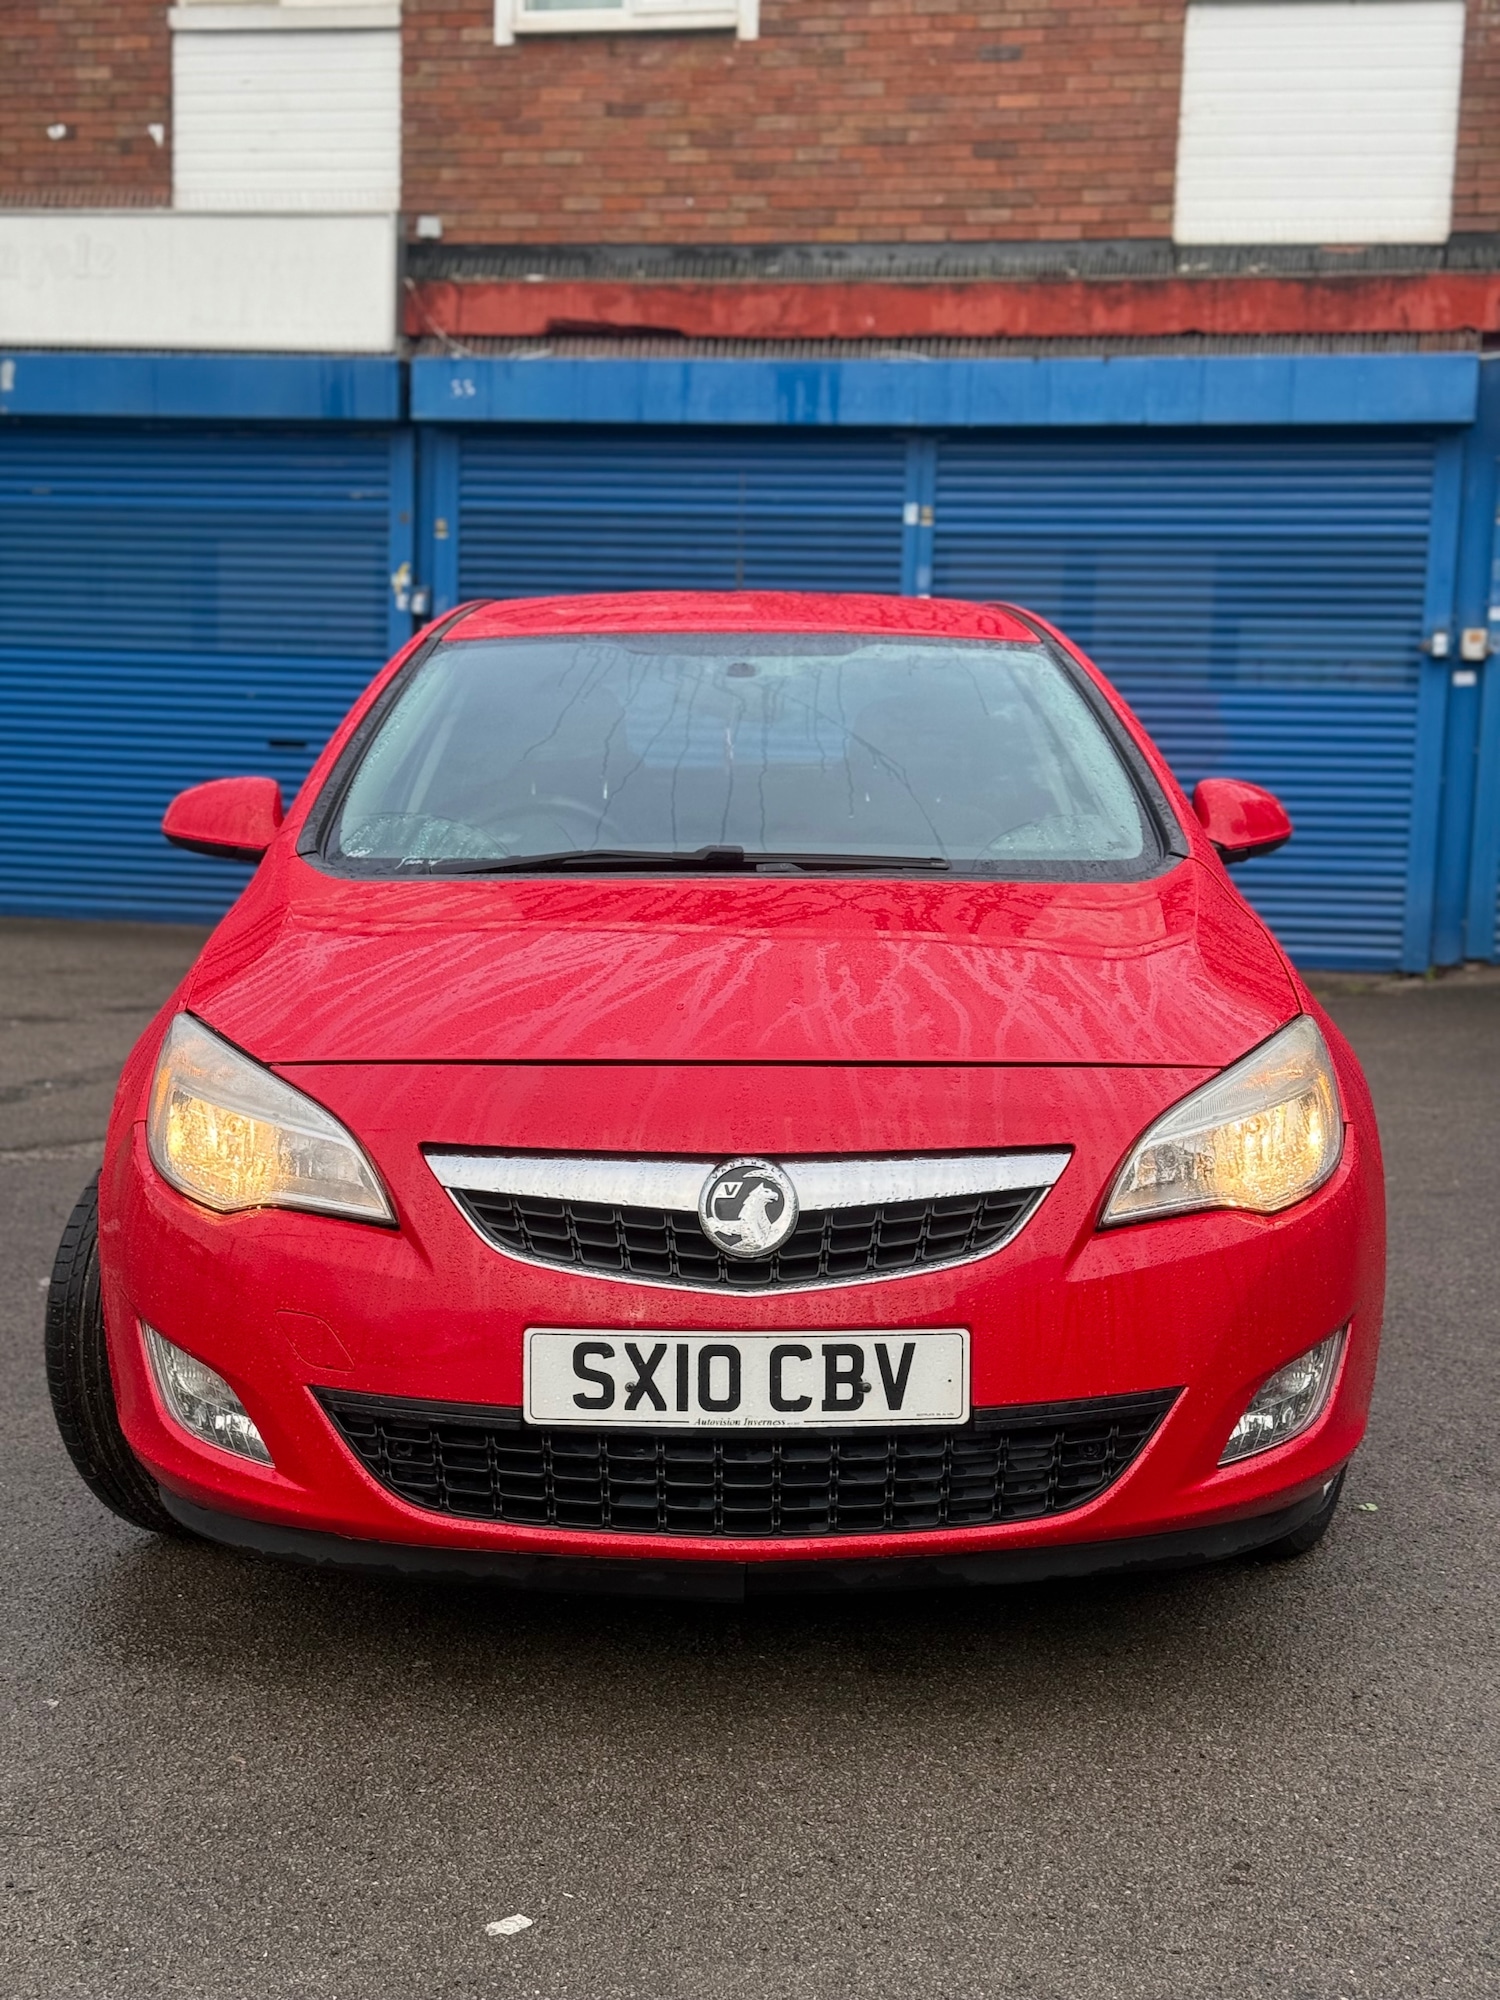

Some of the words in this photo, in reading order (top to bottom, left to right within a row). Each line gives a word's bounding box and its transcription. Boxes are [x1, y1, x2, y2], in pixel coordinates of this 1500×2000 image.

[724, 1184, 738, 1196] V
[573, 1342, 741, 1412] SX10
[770, 1343, 916, 1412] CBV
[694, 1417, 740, 1426] Autovision
[743, 1417, 786, 1426] Inverness
